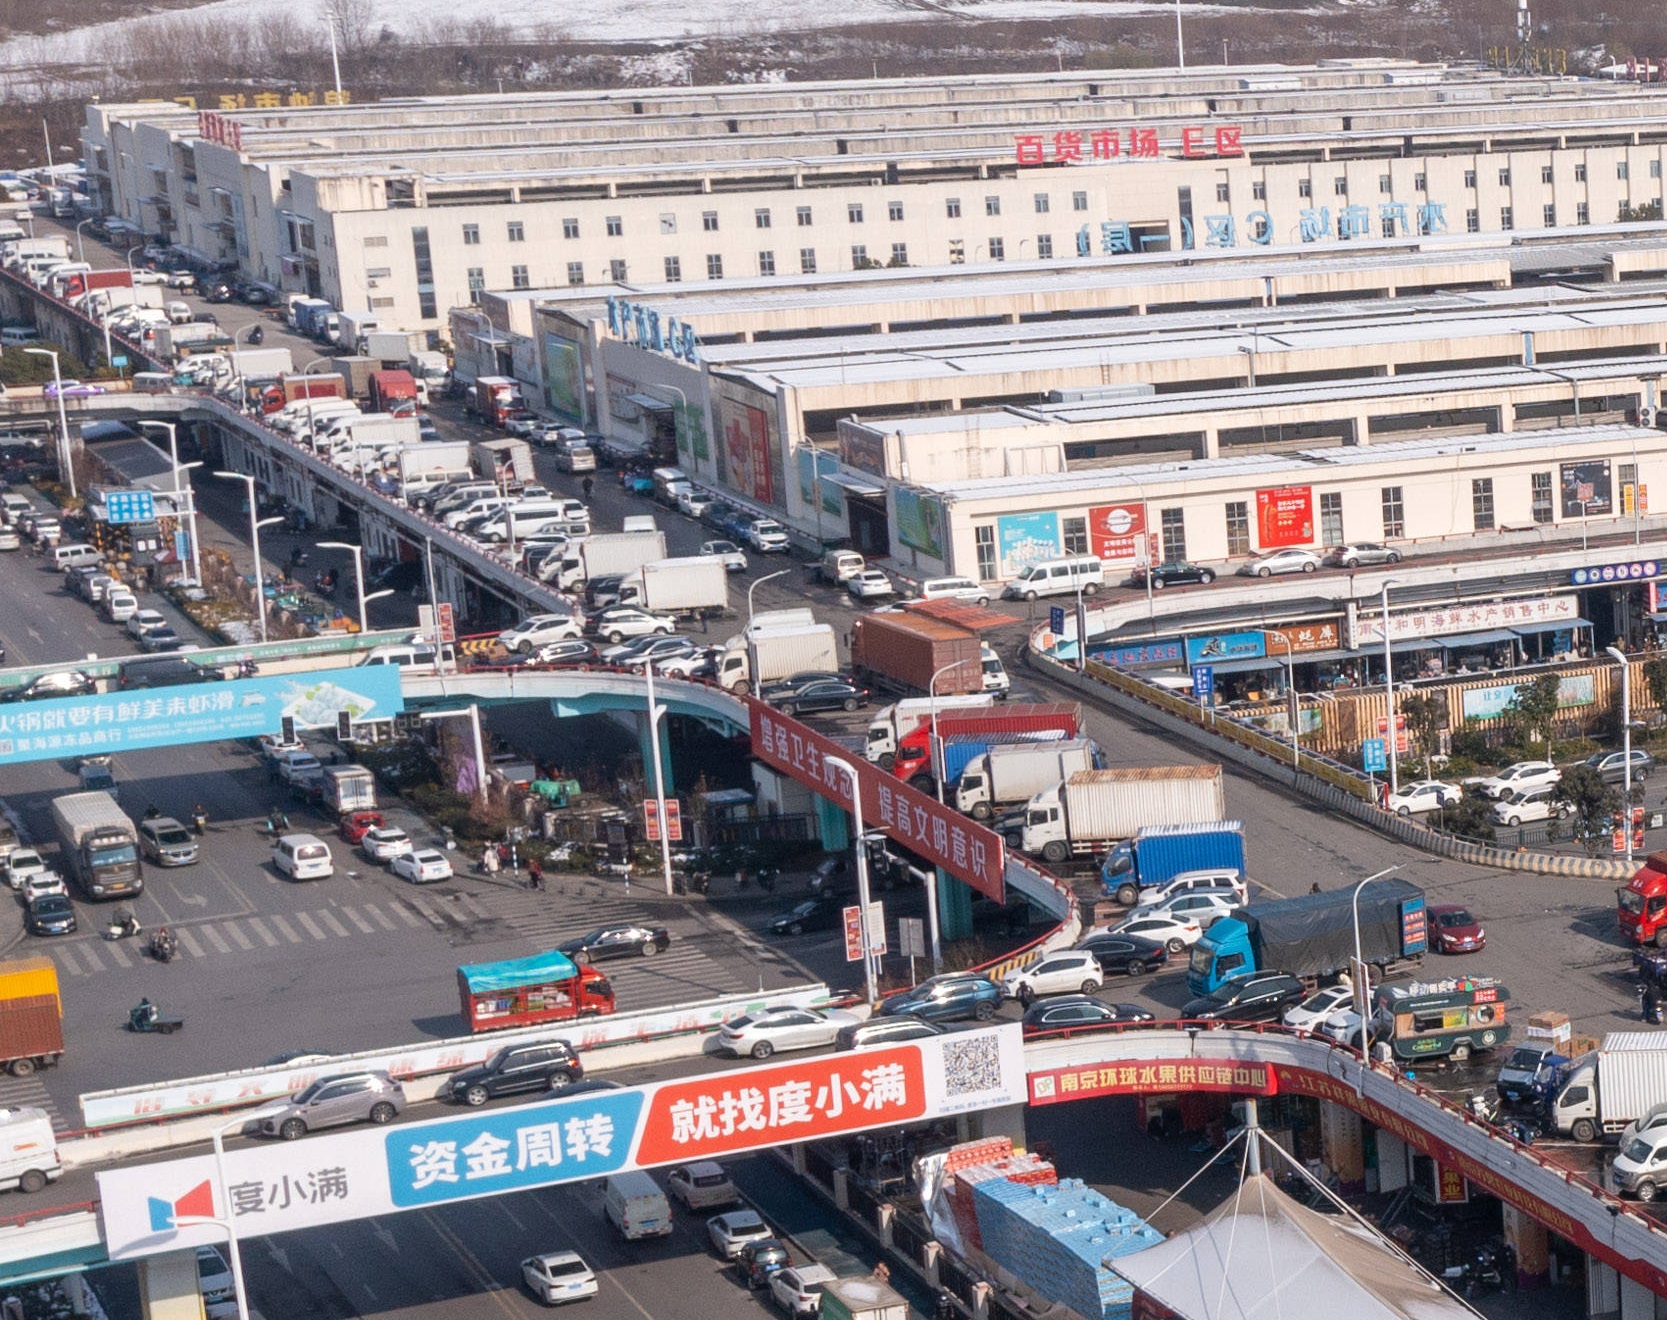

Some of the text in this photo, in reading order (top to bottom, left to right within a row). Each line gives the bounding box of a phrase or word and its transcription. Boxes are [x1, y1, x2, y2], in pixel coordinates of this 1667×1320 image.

[1014, 126, 1245, 166] 百货市场 E区
[878, 782, 989, 883] 提高文明意识
[668, 1060, 909, 1146] 就找度小满
[1060, 1064, 1268, 1091] 南京环球水果供应链中心
[407, 1111, 615, 1190] 资金周转
[229, 1161, 350, 1218] 度小满
